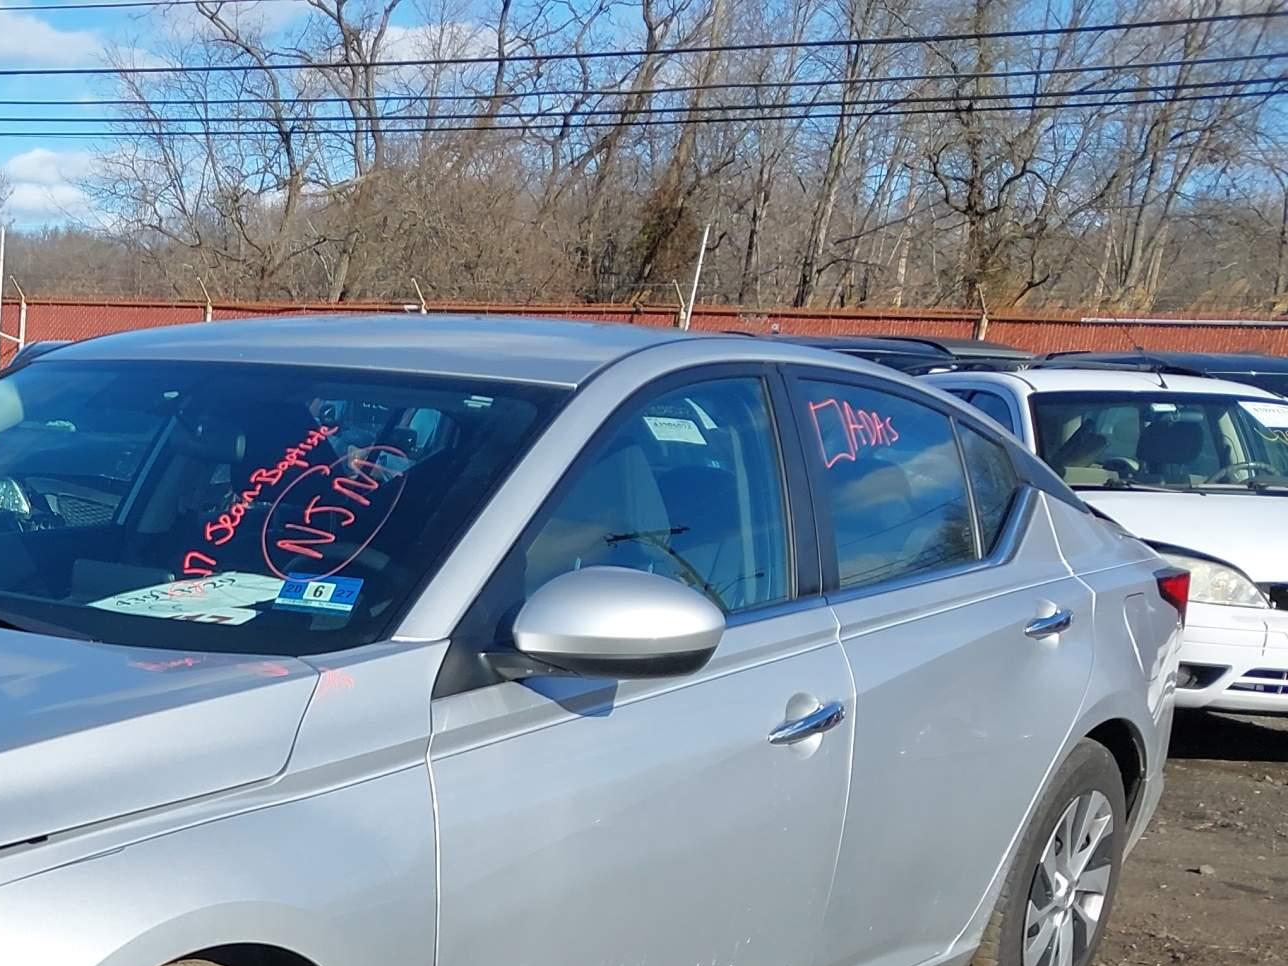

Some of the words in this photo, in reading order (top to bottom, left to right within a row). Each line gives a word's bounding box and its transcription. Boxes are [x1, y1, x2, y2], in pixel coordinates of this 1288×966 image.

[275, 458, 404, 560] NJM
[285, 583, 303, 593] 20
[312, 584, 326, 598] 6
[335, 589, 354, 599] 27
